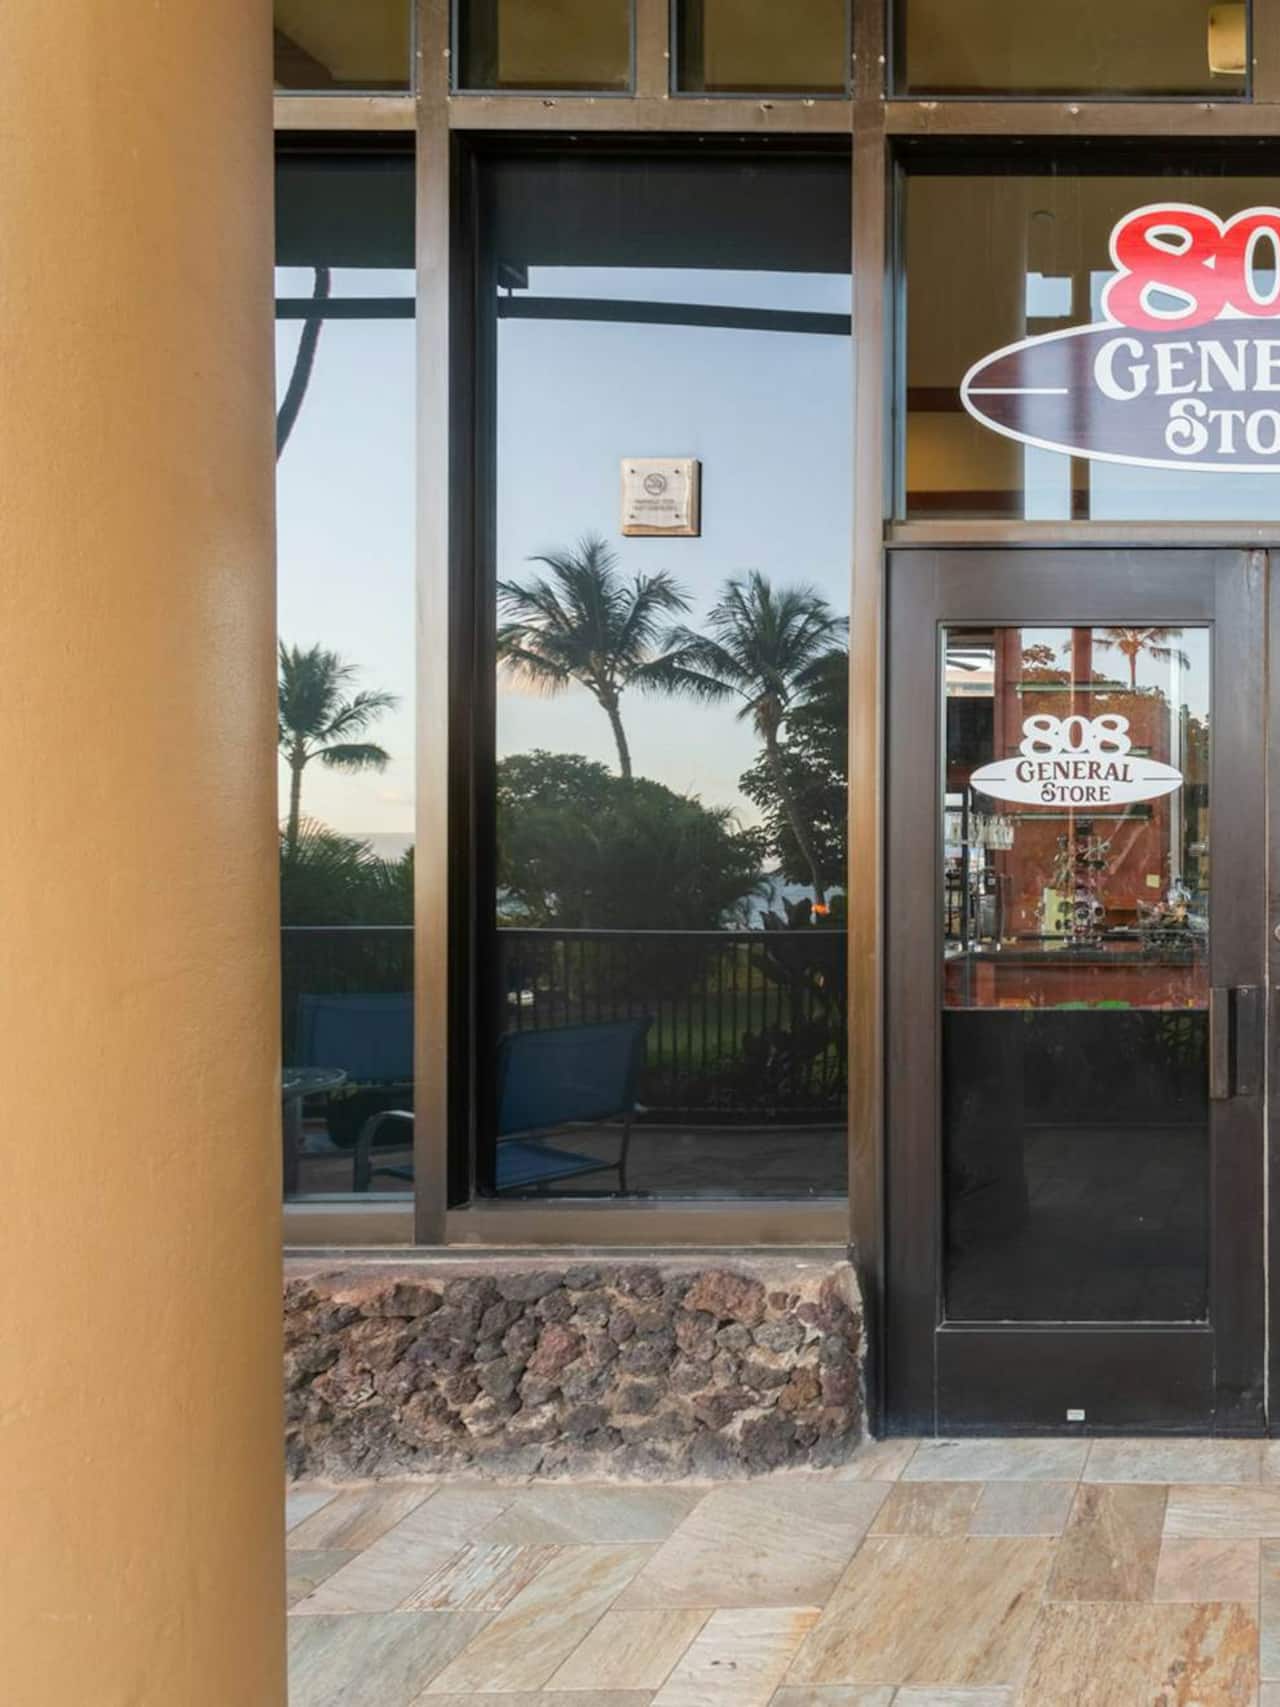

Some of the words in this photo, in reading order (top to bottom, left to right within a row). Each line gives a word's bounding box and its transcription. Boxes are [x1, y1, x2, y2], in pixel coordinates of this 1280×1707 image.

[1020, 713, 1132, 757] 808
[1015, 760, 1134, 783] GENERAL
[1041, 782, 1111, 802] STORE
